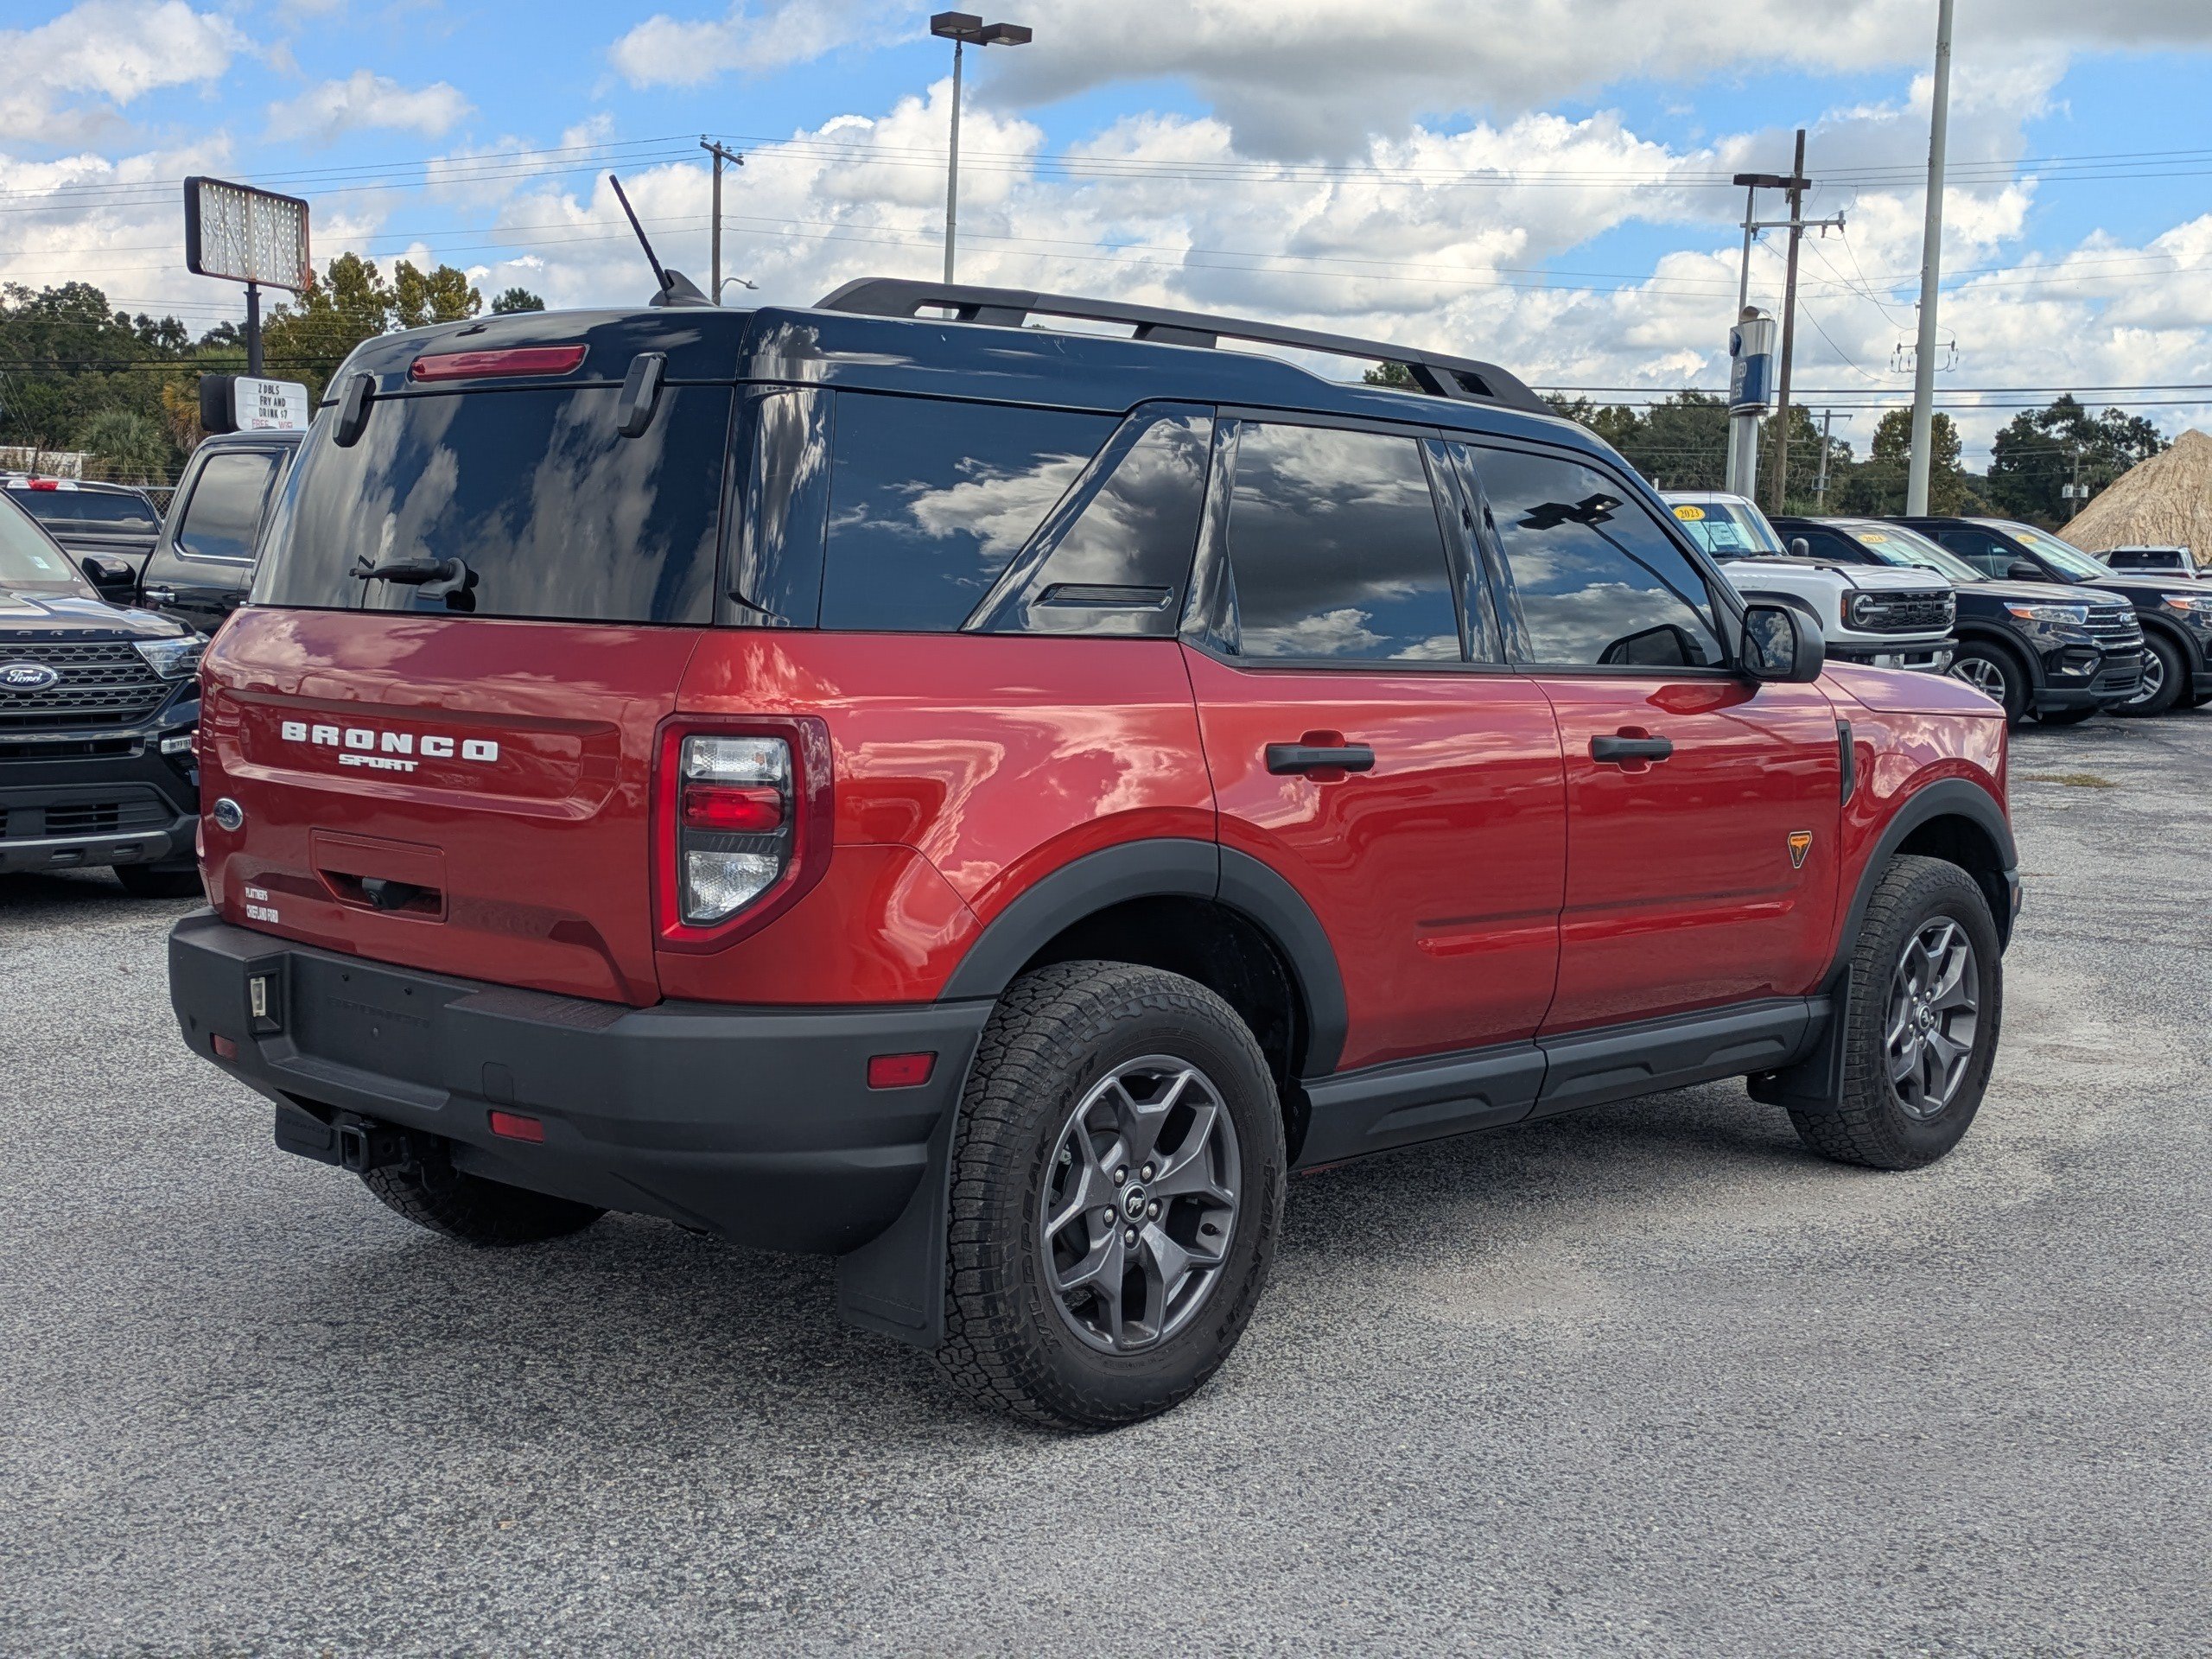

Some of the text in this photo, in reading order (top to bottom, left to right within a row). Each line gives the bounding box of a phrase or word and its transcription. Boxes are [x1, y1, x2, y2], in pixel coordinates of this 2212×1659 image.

[264, 385, 280, 395] DBLS
[260, 396, 286, 407] FRY AND
[259, 408, 288, 419] DRINK $7
[1679, 508, 1700, 518] 2023
[6, 669, 43, 683] Ford
[282, 721, 499, 762] BRONCO
[338, 753, 419, 772] SPORT
